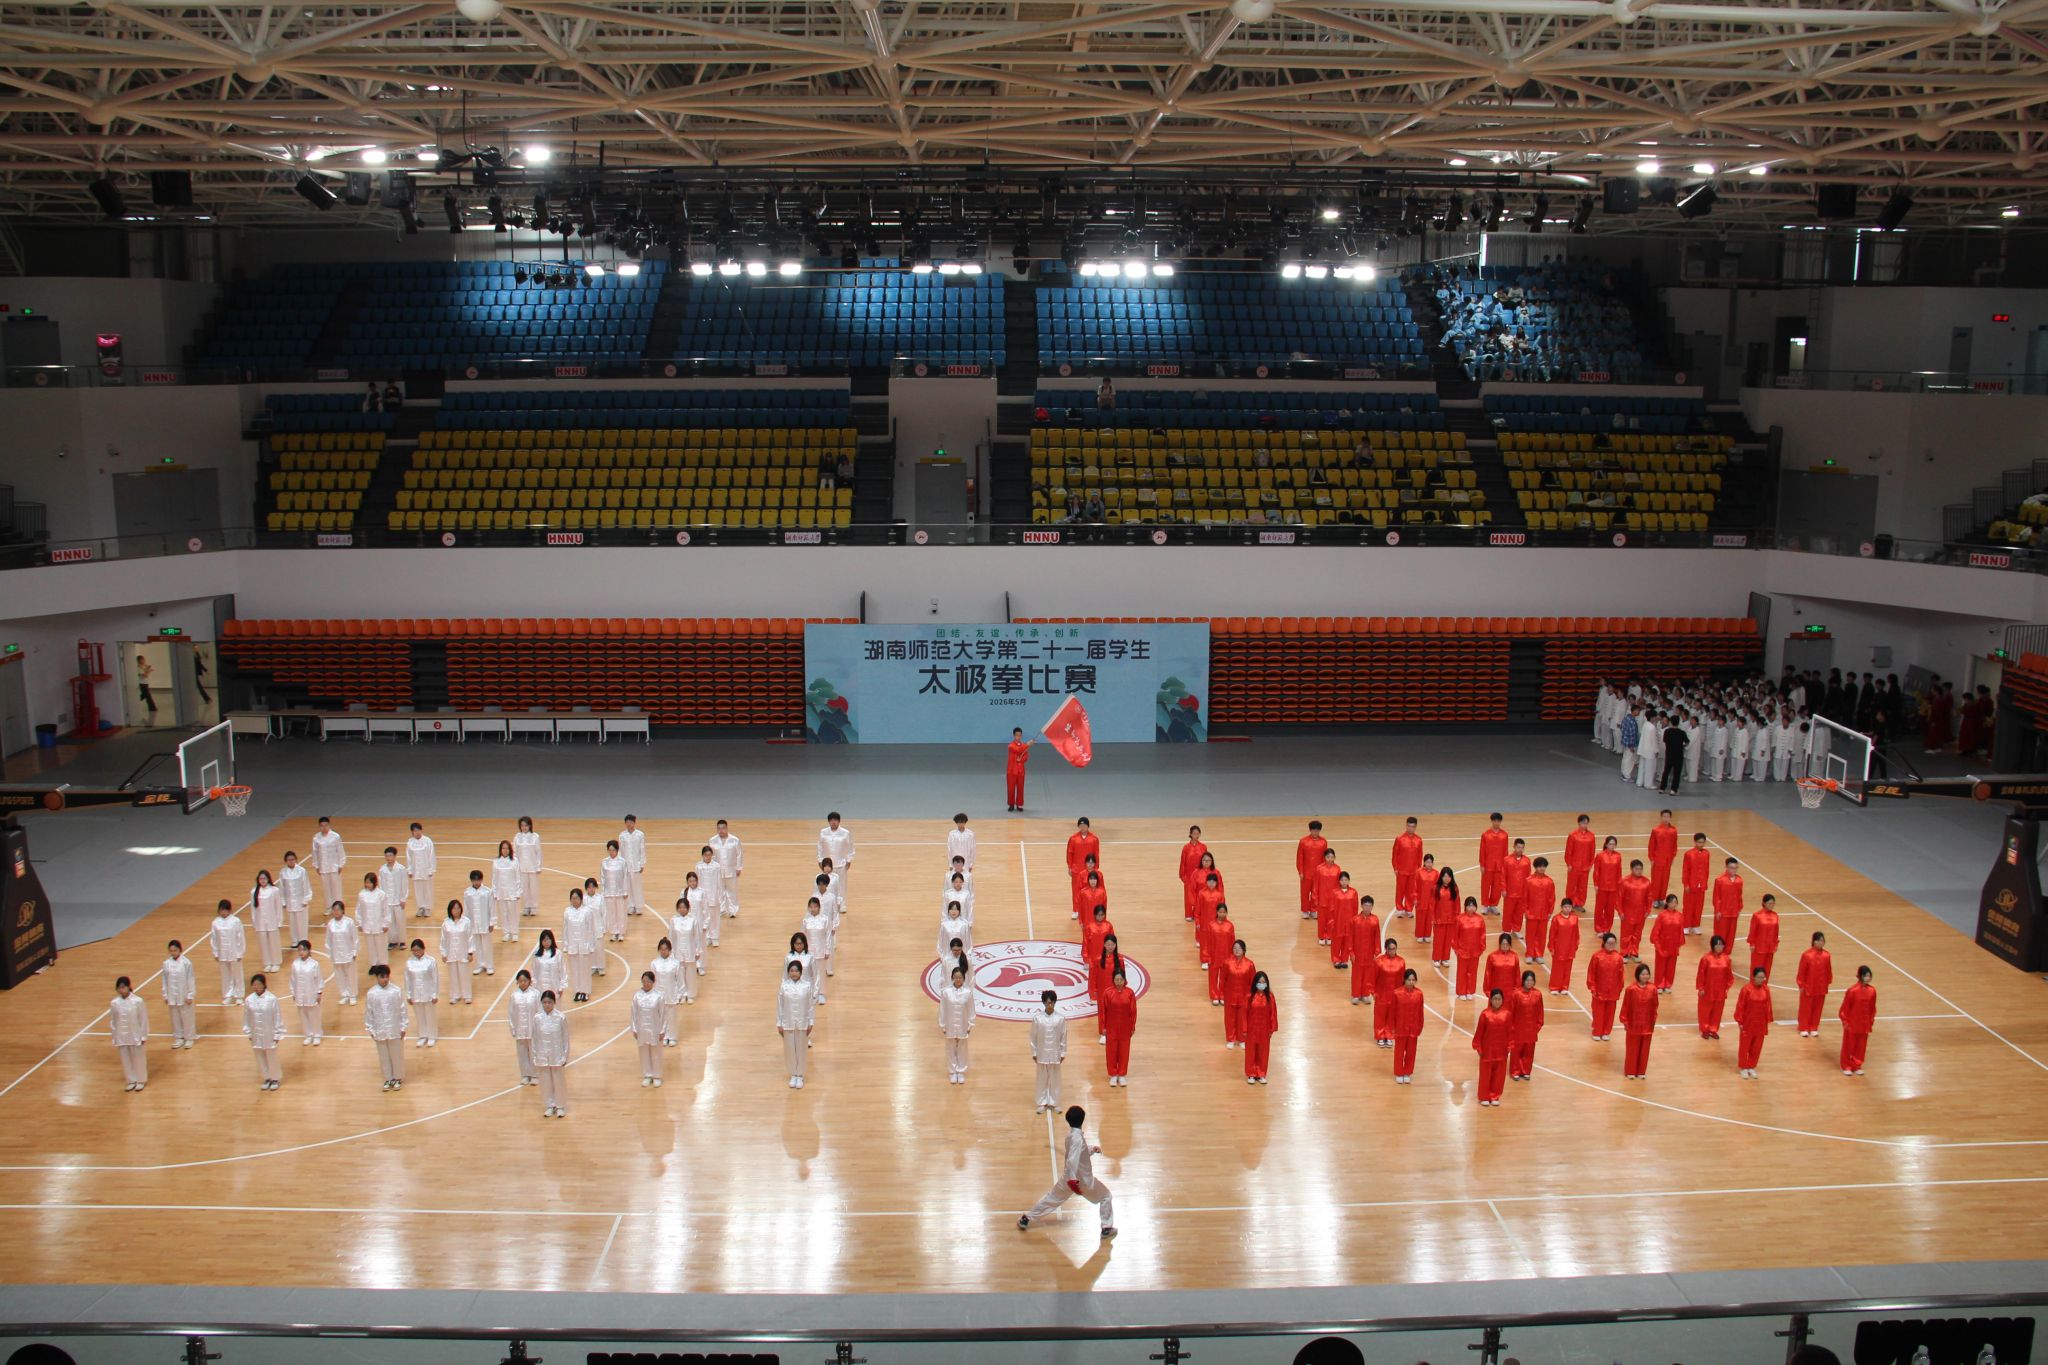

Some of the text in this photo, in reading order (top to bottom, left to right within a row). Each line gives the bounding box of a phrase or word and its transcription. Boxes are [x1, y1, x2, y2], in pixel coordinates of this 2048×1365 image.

[949, 366, 980, 375] HNNU
[1148, 366, 1179, 375] HNNU
[143, 373, 176, 382] HNNU
[1975, 382, 2004, 390] HNNU
[549, 534, 582, 543] HNNU
[1024, 533, 1059, 542] HNNU
[1491, 534, 1525, 543] HNNU
[53, 549, 91, 561] HNNU
[1971, 554, 2009, 566] HNNU
[864, 639, 1151, 660] 湖南师范大学第二十一届学生
[918, 664, 1097, 694] 太极拳比赛
[989, 698, 1026, 706] 2026年5月
[976, 1000, 1043, 1014] NORMA
